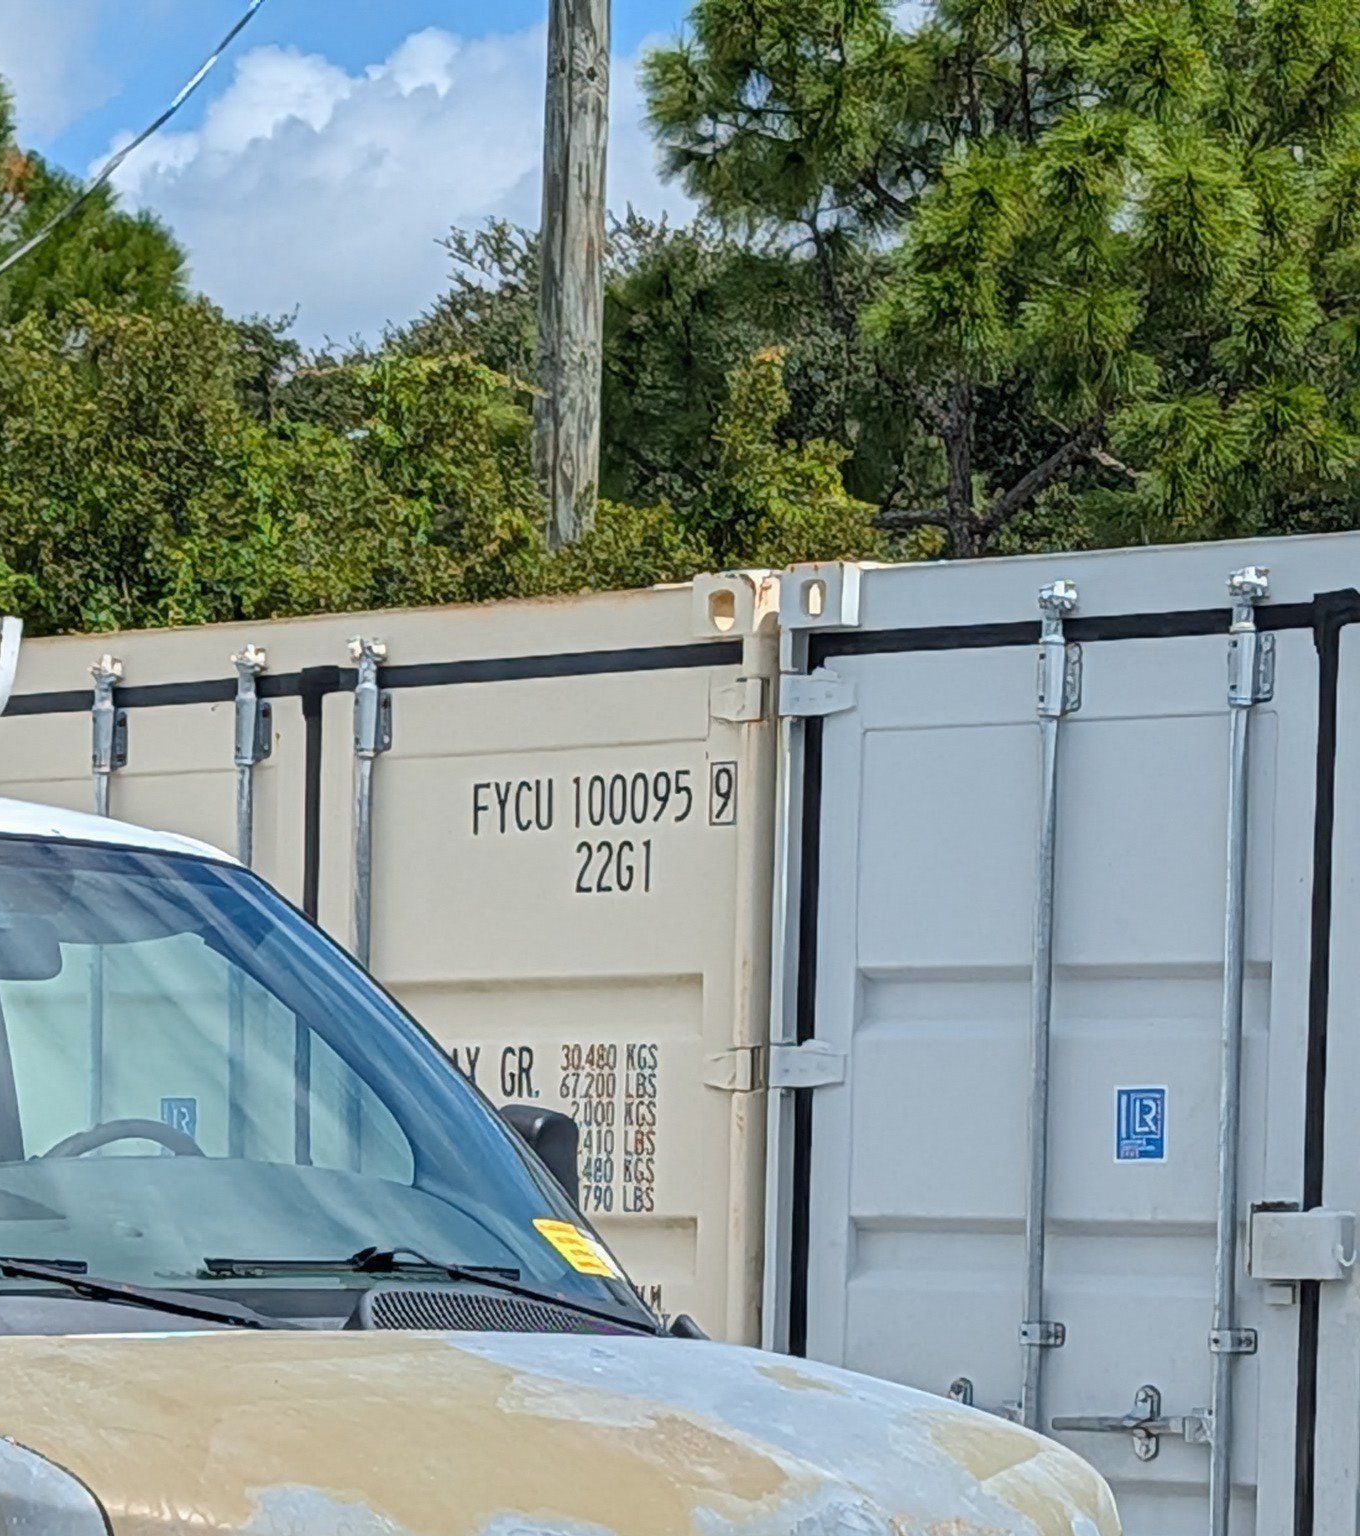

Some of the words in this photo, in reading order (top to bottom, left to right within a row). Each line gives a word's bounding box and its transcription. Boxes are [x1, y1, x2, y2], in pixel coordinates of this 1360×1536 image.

[473, 778, 553, 835] FYCU
[573, 770, 692, 828] 100095
[714, 766, 733, 821] 9
[576, 839, 651, 892] 22G1
[560, 1043, 617, 1071] 30.480
[625, 1043, 658, 1070] KGS
[624, 1072, 657, 1099] LBS
[623, 1100, 656, 1127] KGS
[623, 1129, 656, 1156] LBS
[623, 1157, 655, 1183] KGS
[582, 1184, 614, 1212] 790
[622, 1185, 655, 1212] LBS
